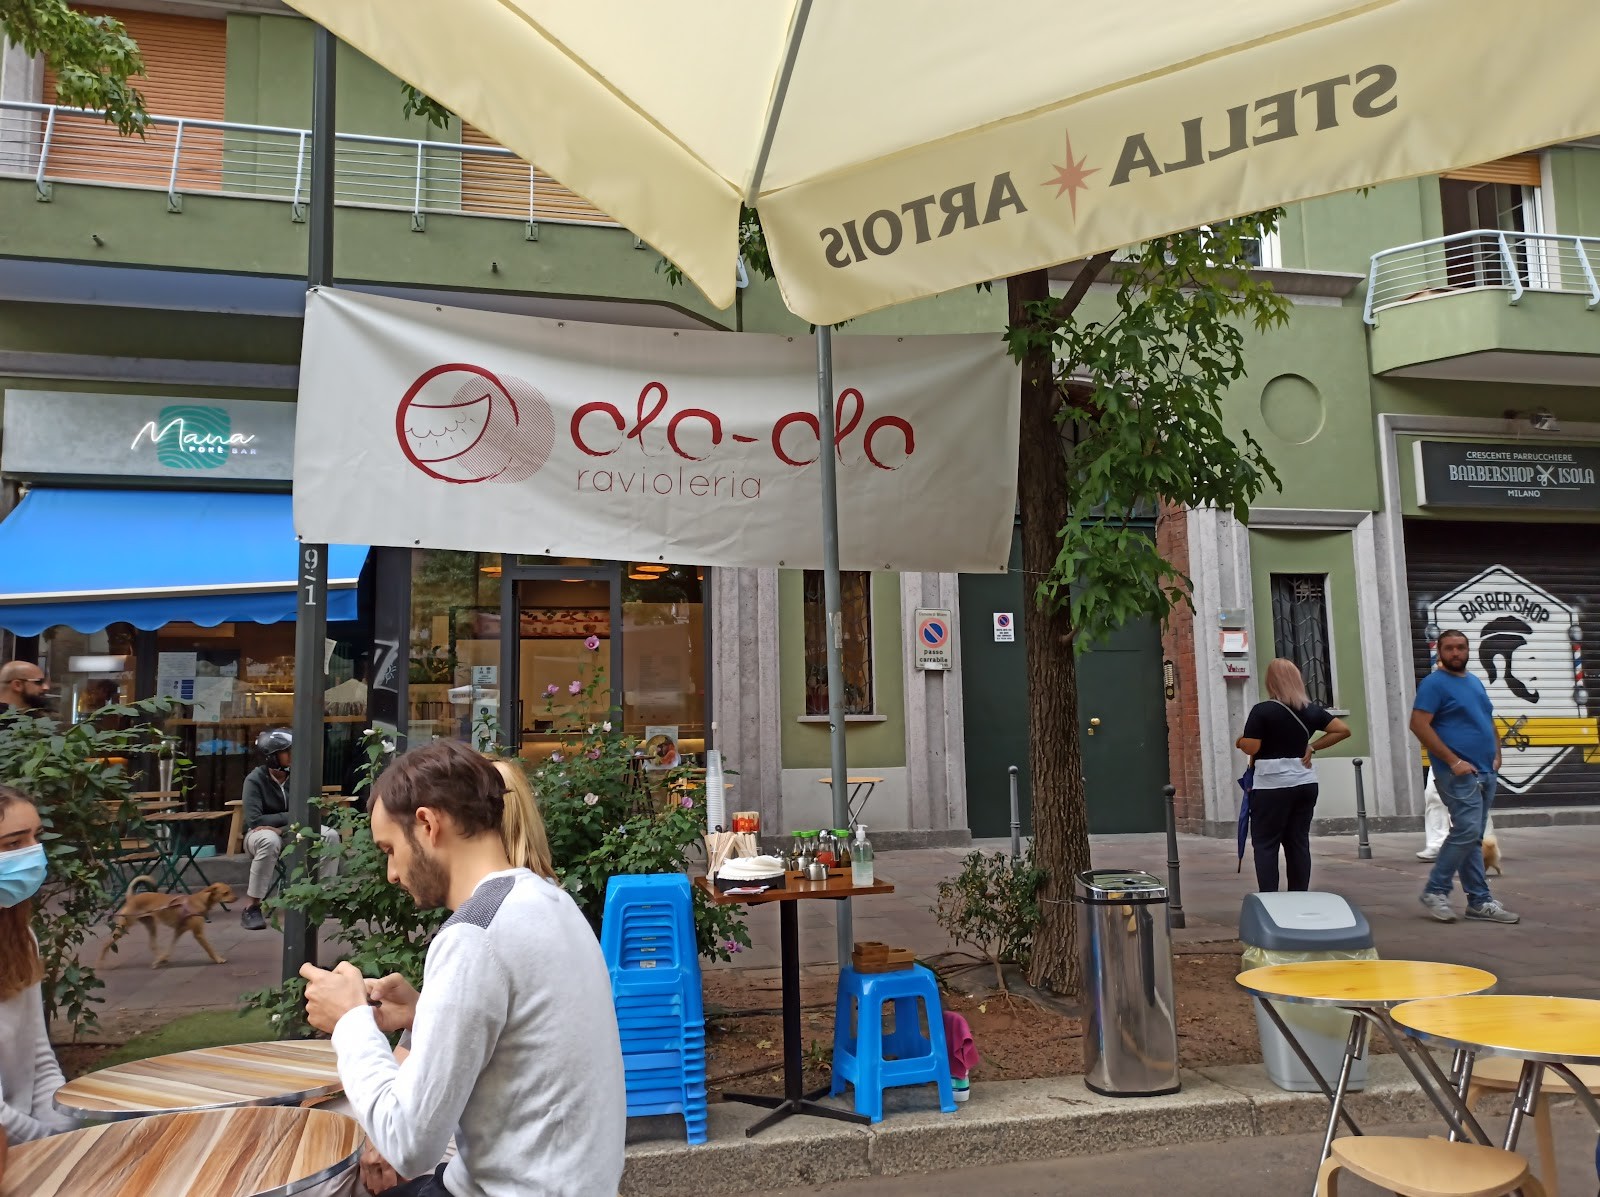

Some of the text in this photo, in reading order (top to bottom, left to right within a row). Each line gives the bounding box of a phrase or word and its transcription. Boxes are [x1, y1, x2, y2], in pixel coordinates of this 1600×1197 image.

[131, 418, 256, 452] Mana
[1466, 451, 1573, 462] CRESCENTE PARRUCCHIERE
[577, 467, 761, 499] ravioleria
[1449, 464, 1595, 484] BARBERSHOP ISOLA
[1507, 489, 1541, 498] MILANO
[1458, 592, 1550, 623] BARBER SHOP
